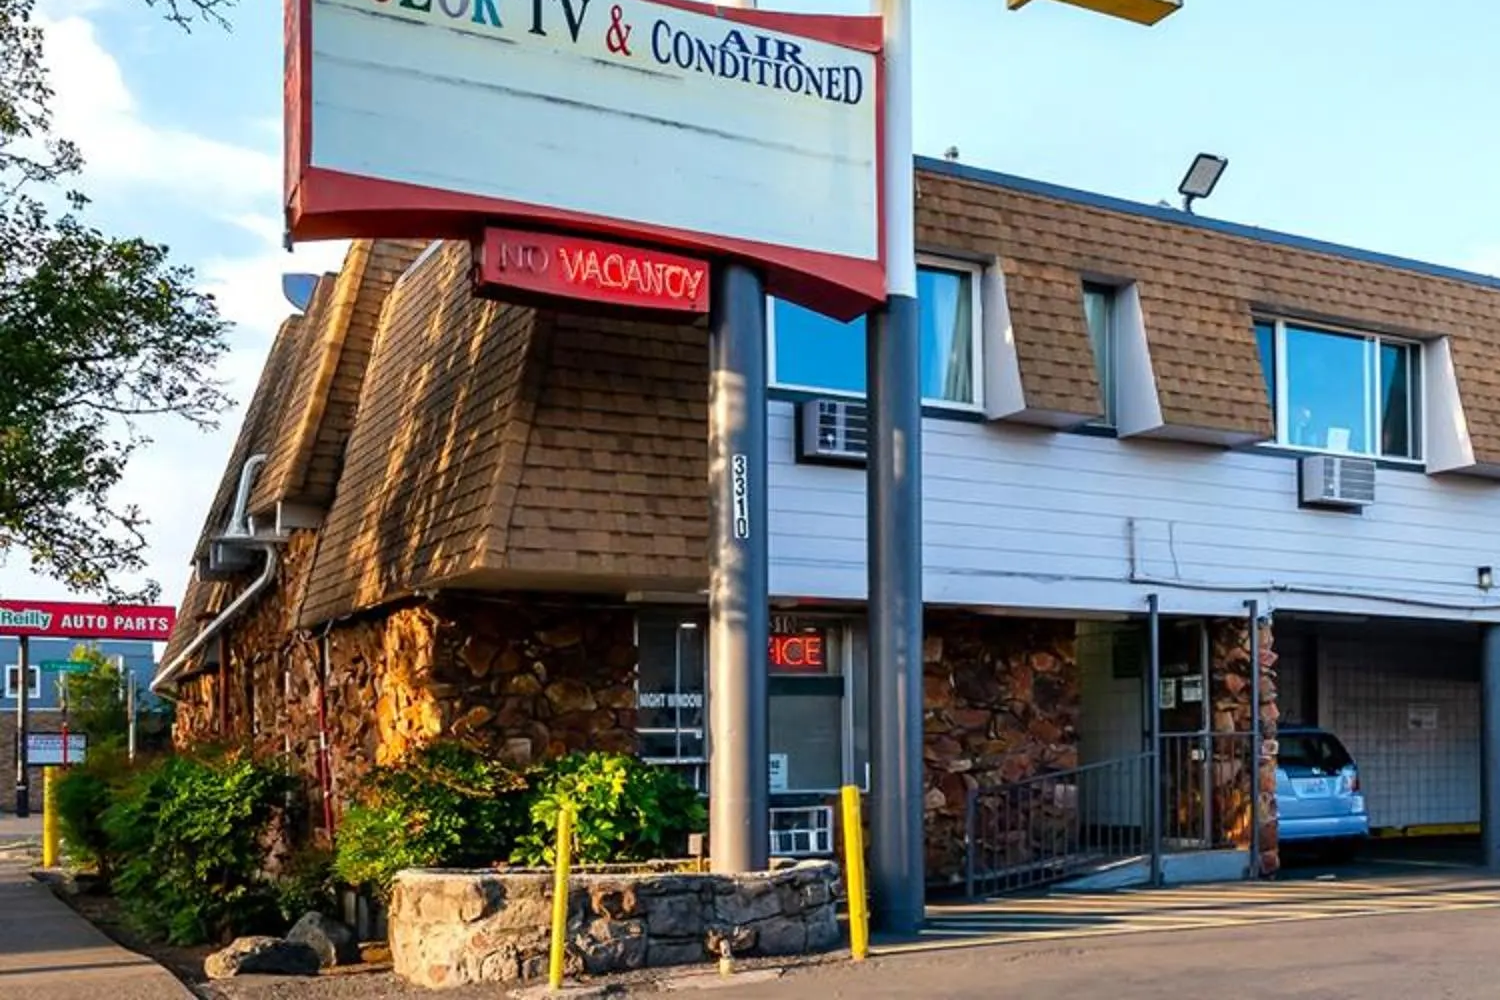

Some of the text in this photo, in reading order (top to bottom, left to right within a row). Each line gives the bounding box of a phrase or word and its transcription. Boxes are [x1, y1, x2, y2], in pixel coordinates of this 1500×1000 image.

[605, 4, 633, 56] &
[720, 29, 807, 67] AIR
[500, 243, 704, 299] NO VACANCY
[734, 455, 747, 537] 3310
[61, 614, 108, 629] AUTO
[114, 616, 169, 631] PARTS
